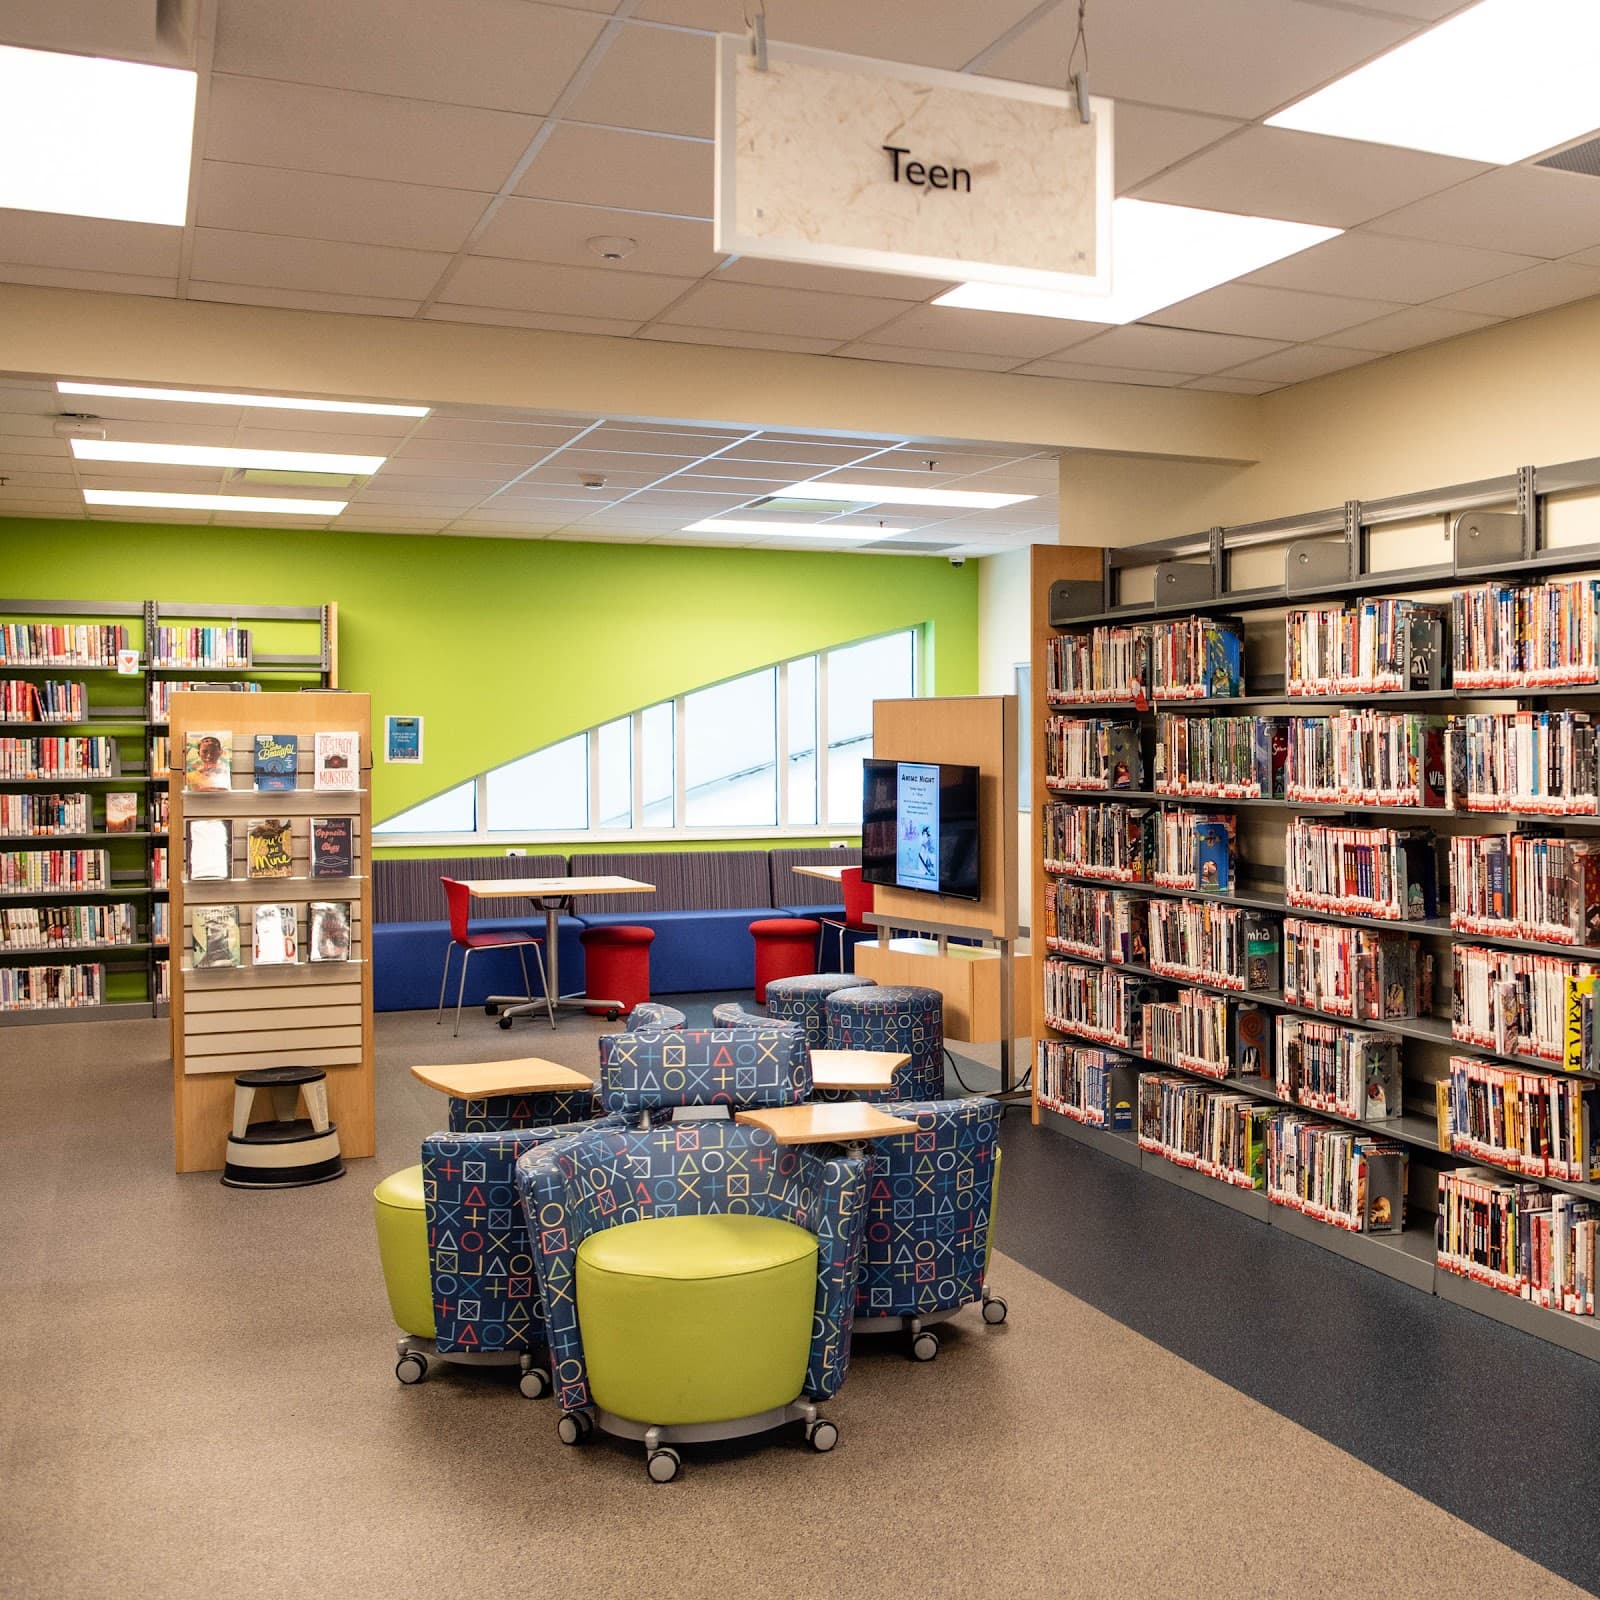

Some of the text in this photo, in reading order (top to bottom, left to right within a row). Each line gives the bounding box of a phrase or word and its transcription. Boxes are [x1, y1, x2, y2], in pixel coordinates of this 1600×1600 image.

[882, 144, 971, 193] Teen
[319, 737, 353, 756] DESTROY
[319, 769, 354, 785] MONSTERS
[253, 853, 292, 871] Mine
